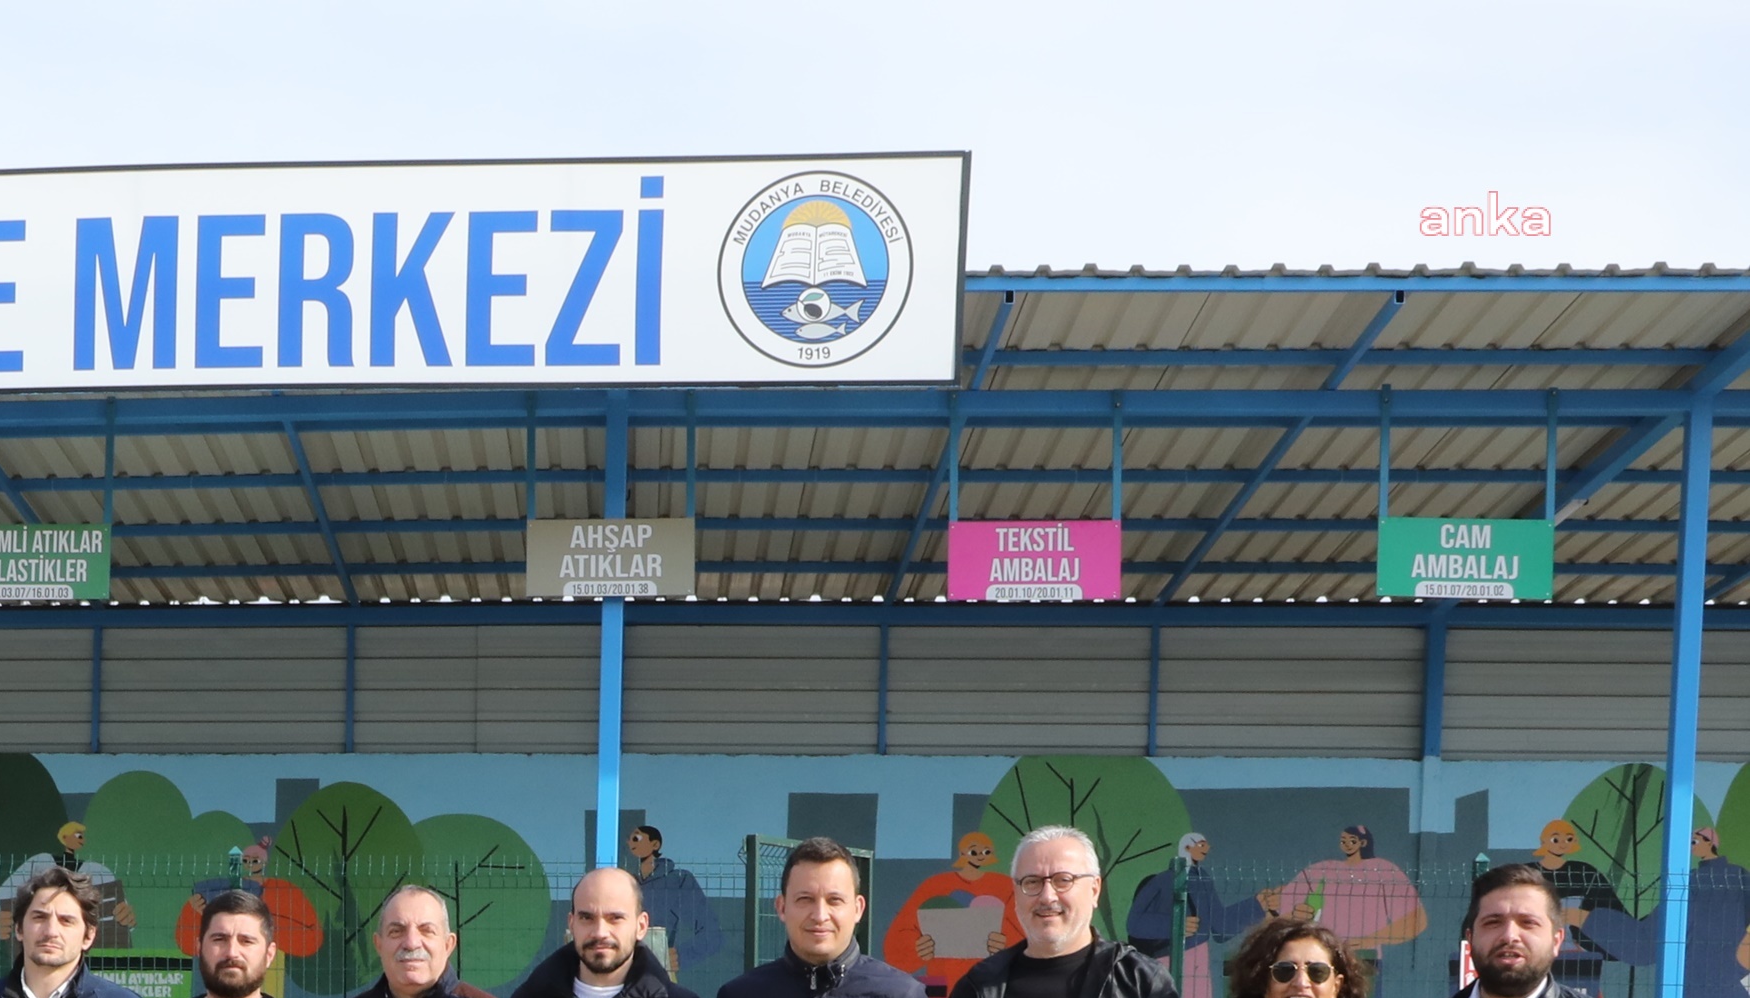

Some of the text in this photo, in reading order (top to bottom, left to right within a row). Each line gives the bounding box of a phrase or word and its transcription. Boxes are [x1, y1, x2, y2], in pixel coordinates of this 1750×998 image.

[733, 179, 904, 246] MUDANYA BELEDİYESİ
[72, 175, 665, 371] MERKEZİ
[797, 346, 831, 360] 1919
[32, 530, 103, 553] ATIKLAR
[570, 524, 652, 553] AHŞAP
[995, 523, 1075, 552] TEKSTİL
[1440, 523, 1491, 549] CAM
[559, 554, 662, 578] ATIKLAR
[989, 557, 1080, 582] AMBALAJ
[1411, 554, 1519, 580] AMBALAJ
[572, 583, 649, 595] 15.01.03/20.01.38
[995, 587, 1074, 599] 20.01.10/20.01.11
[1425, 584, 1504, 596] 15.01.07/20.01.02
